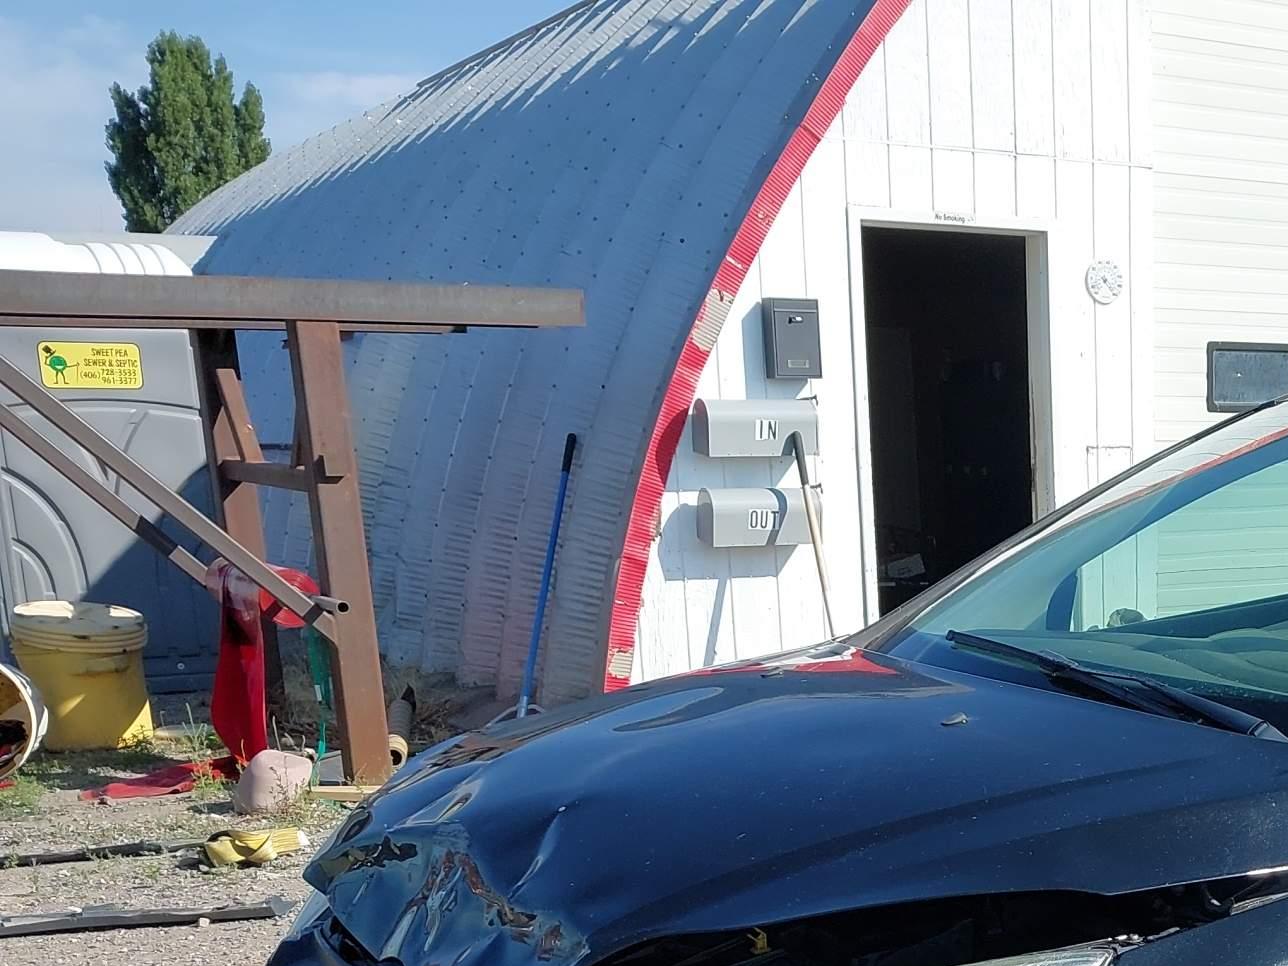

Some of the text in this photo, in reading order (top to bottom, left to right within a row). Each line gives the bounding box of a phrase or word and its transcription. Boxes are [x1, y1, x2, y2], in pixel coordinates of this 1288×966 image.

[91, 348, 128, 357] SWEET PEA
[83, 358, 138, 368] SEWER & SEPTIC
[80, 371, 101, 379] (406)
[759, 420, 777, 440] IN
[750, 510, 780, 529] OUT
